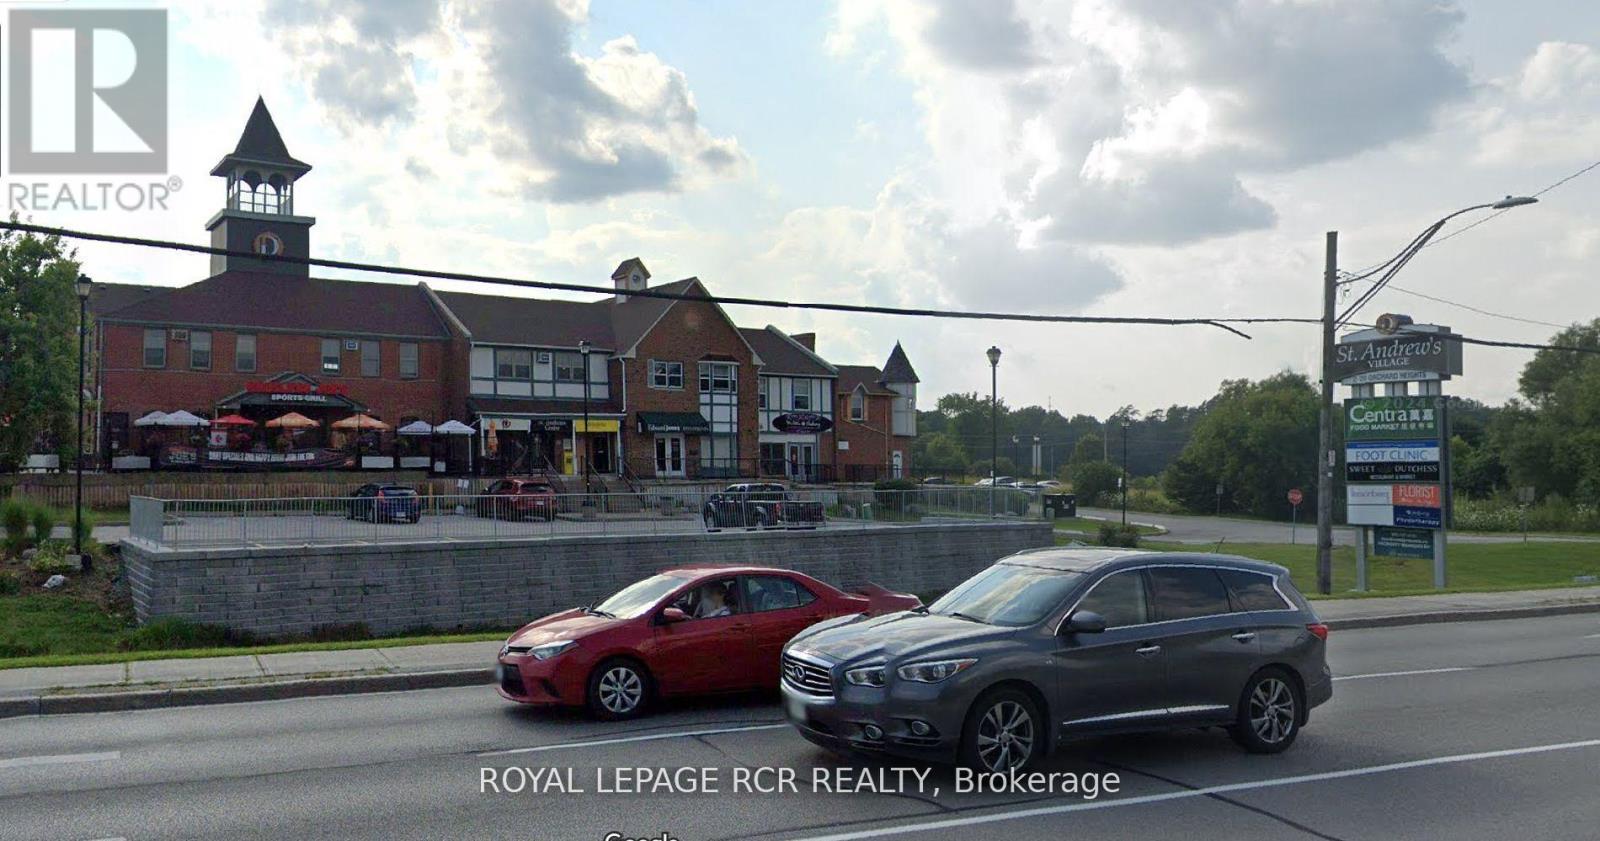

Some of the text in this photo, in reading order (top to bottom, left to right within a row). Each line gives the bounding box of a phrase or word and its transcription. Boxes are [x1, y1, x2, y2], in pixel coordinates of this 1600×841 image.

[1335, 336, 1442, 363] St. Andrew's
[1368, 358, 1410, 369] VILLAGE
[271, 394, 326, 402] SPORTS GRILL
[1349, 405, 1408, 423] Centra
[1349, 423, 1370, 432] FOOD
[1371, 422, 1400, 431] MARKET
[1355, 449, 1428, 461] FOOT CLINIC
[1349, 465, 1438, 473] SWEET DUTCHESS
[1399, 485, 1434, 498] FLORIST
